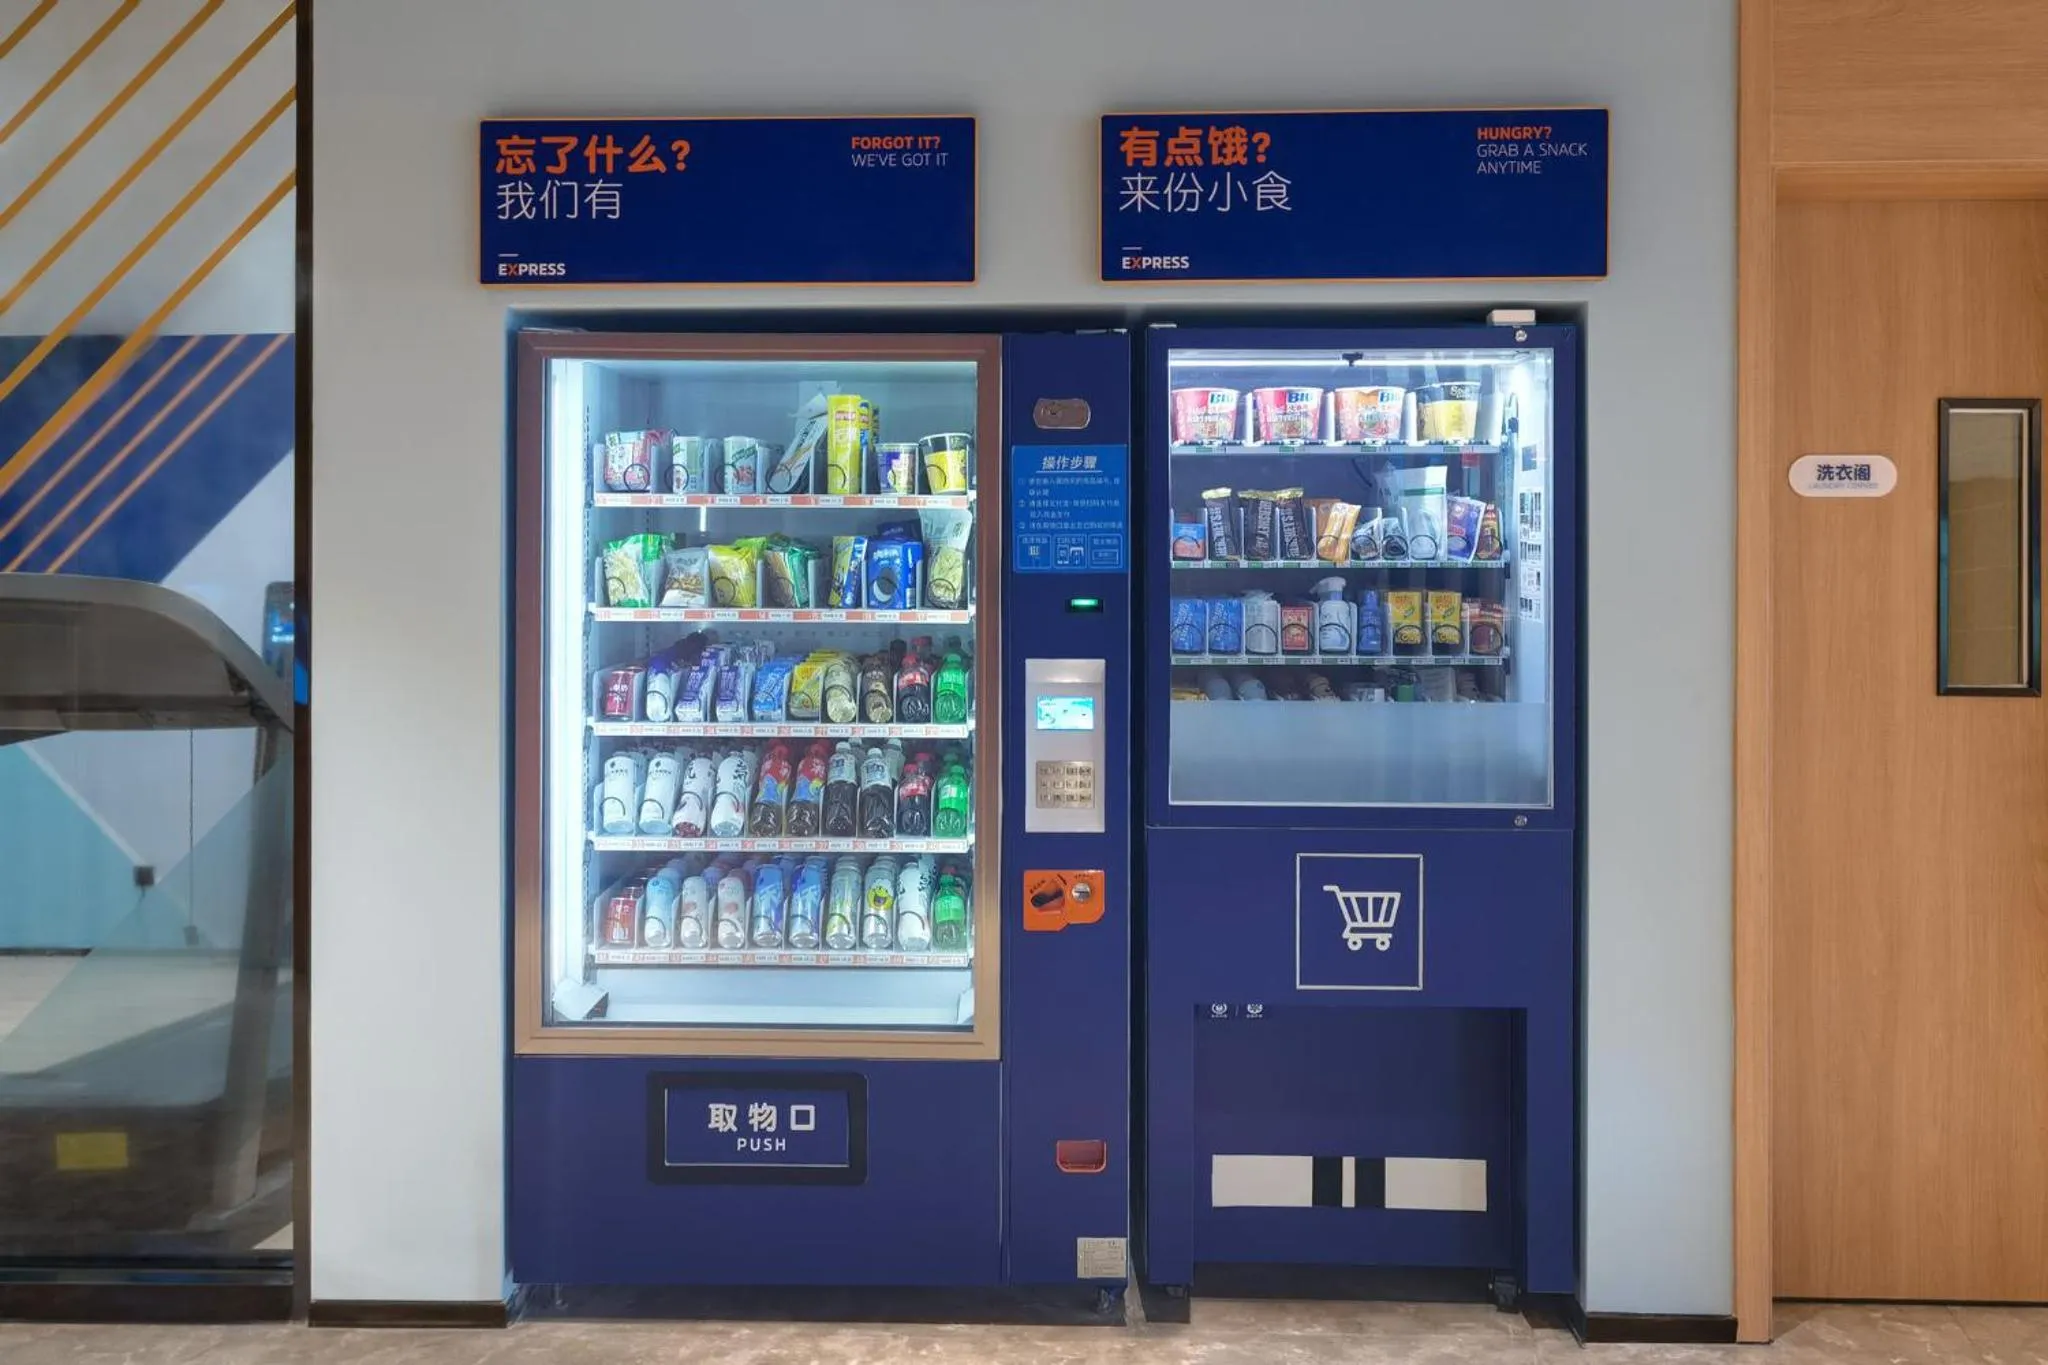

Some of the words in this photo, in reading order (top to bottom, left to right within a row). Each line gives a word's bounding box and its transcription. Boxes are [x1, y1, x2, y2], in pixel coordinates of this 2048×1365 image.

[1477, 126, 1552, 141] HUNGRY?
[852, 136, 914, 149] FORGOT
[918, 136, 941, 149] IT?
[1119, 126, 1271, 167] 有点饿?
[1477, 143, 1518, 157] GRAB
[1522, 143, 1535, 156] A
[1539, 143, 1587, 156] SNACK
[496, 135, 691, 175] 忘了什么?
[852, 153, 897, 167] WE'VE
[901, 153, 931, 166] GOT
[935, 153, 949, 166] IT
[1477, 160, 1542, 174] ANYTIME
[1119, 171, 1292, 212] 来份小食
[497, 179, 623, 220] 我们有
[499, 263, 566, 276] EXPRESS
[1122, 256, 1190, 269] EXPRESS
[1041, 455, 1098, 470] 操作步骤
[1817, 464, 1871, 481] 洗衣阁
[708, 1102, 816, 1132] 取物口
[736, 1138, 786, 1151] PUSH
